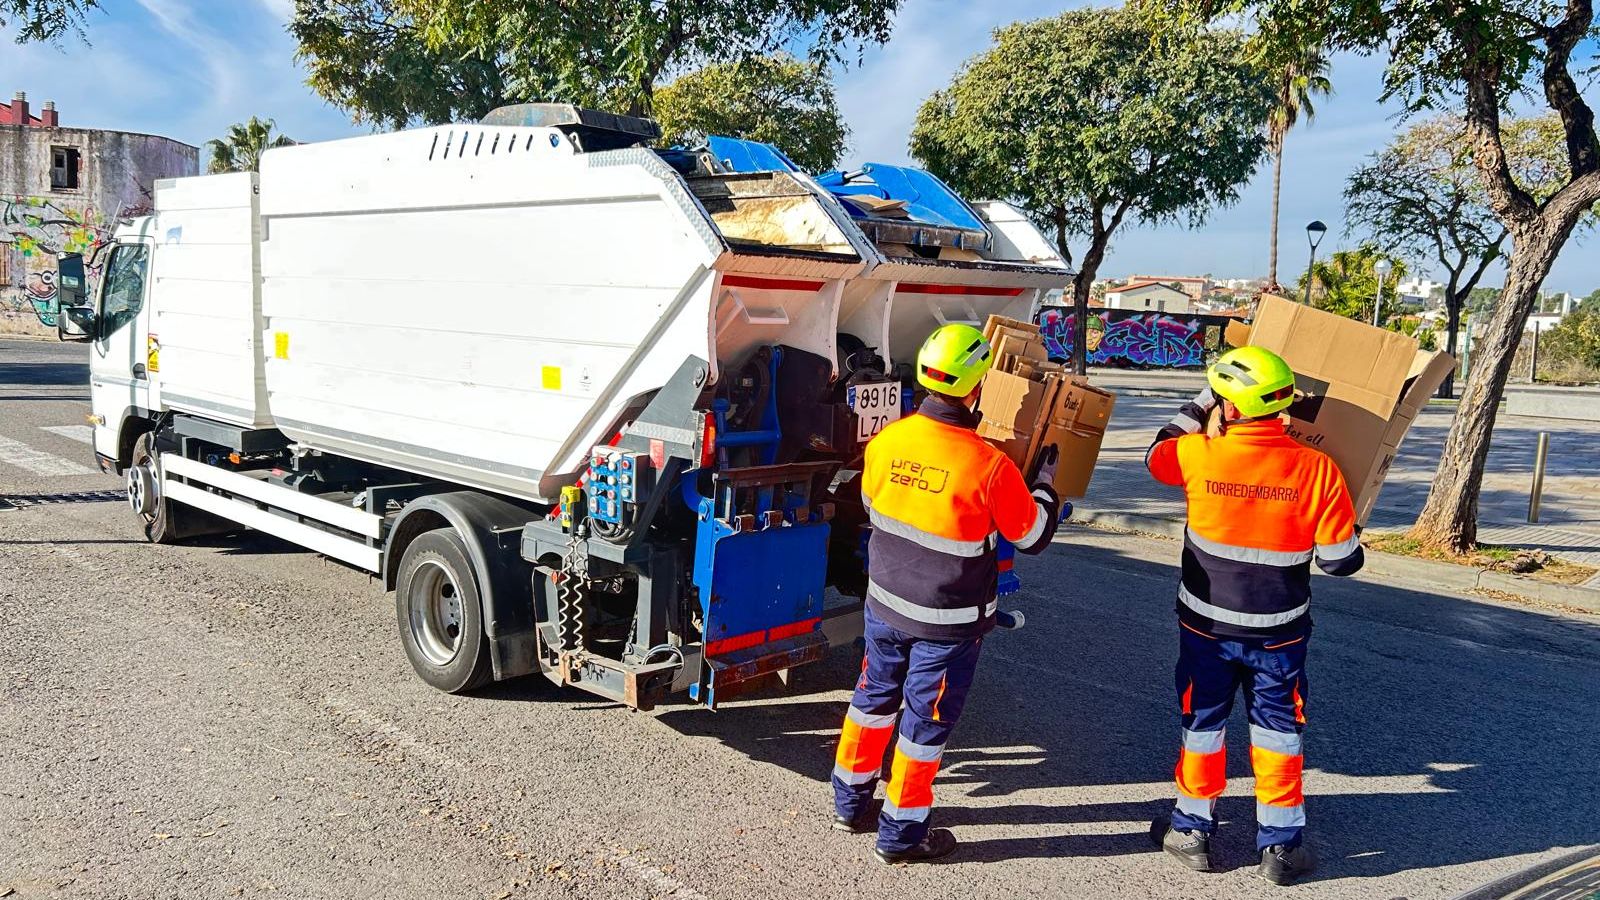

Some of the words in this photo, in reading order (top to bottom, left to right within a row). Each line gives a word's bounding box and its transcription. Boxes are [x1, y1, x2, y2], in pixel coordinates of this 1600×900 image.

[861, 386, 898, 409] 8916
[1306, 433, 1325, 447] all
[891, 459, 921, 473] pre
[890, 472, 928, 490] zero
[1205, 479, 1299, 502] TORREDEMBARRA
